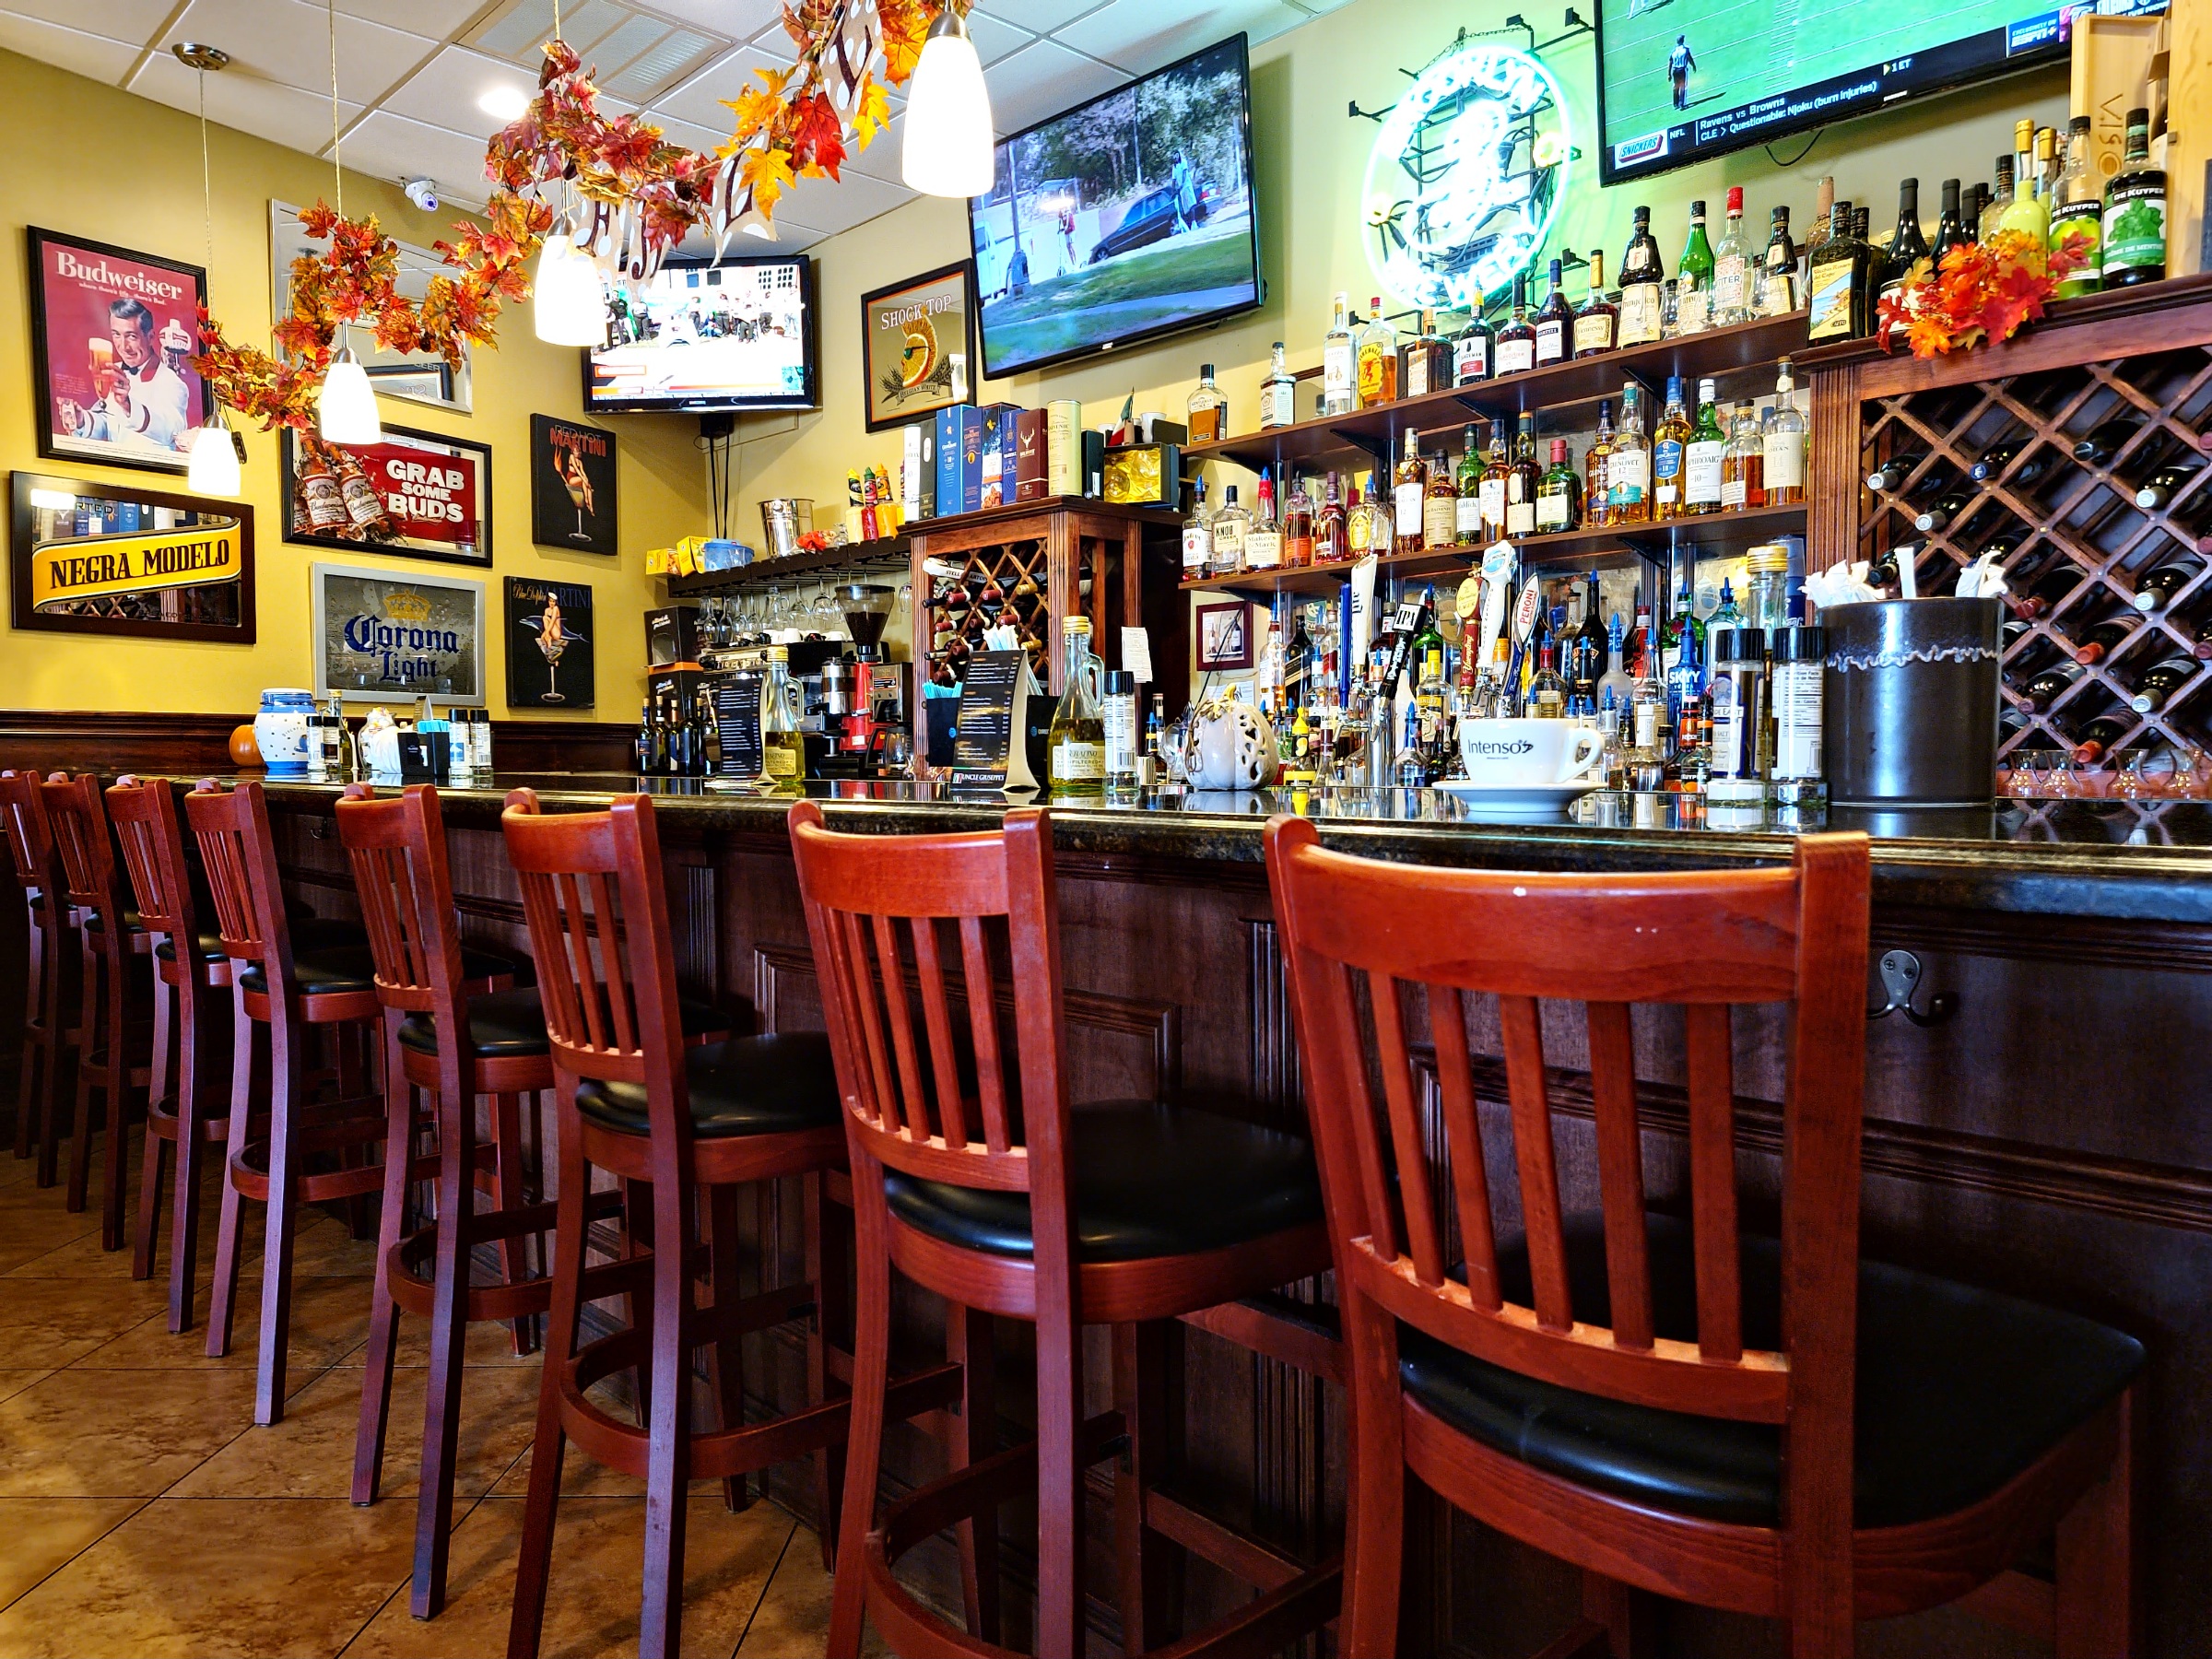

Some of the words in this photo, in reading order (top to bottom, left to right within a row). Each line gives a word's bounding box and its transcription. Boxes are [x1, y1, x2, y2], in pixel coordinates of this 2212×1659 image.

[1899, 59, 1912, 71] ET
[1700, 130, 1718, 142] CLE
[1729, 109, 1786, 134] Questionable:
[1786, 100, 1813, 118] Njoku
[1813, 92, 1839, 110] (burn
[1840, 79, 1877, 103] injuries)
[1700, 112, 1733, 131] Ravens
[1735, 110, 1747, 118] vs
[1748, 96, 1785, 114] Browns
[1669, 129, 1686, 140] NFL
[1619, 136, 1658, 158] SNICKERS
[2114, 192, 2128, 201] DE
[2127, 186, 2165, 197] KUYPER
[2062, 203, 2100, 214] KUYPER
[55, 251, 182, 300] Budweiser
[881, 302, 923, 331] SHOCK
[925, 295, 952, 317] TOP
[549, 428, 607, 458] MARTINI
[555, 424, 577, 440] RED
[578, 432, 602, 445] HOT
[386, 459, 465, 490] GRAB
[1609, 459, 1640, 469] GLENLIVET
[401, 481, 452, 502] SOME
[388, 492, 465, 523] BUDS
[1216, 525, 1233, 537] KNOB
[50, 552, 134, 590] NEGRA
[142, 539, 229, 576] MODELO
[946, 570, 960, 578] STELL
[1520, 589, 1535, 625] PERONI
[344, 614, 460, 658] Corona
[379, 650, 439, 683] Light
[1668, 670, 1701, 685] SKYY
[1467, 739, 1522, 755] Intenso
